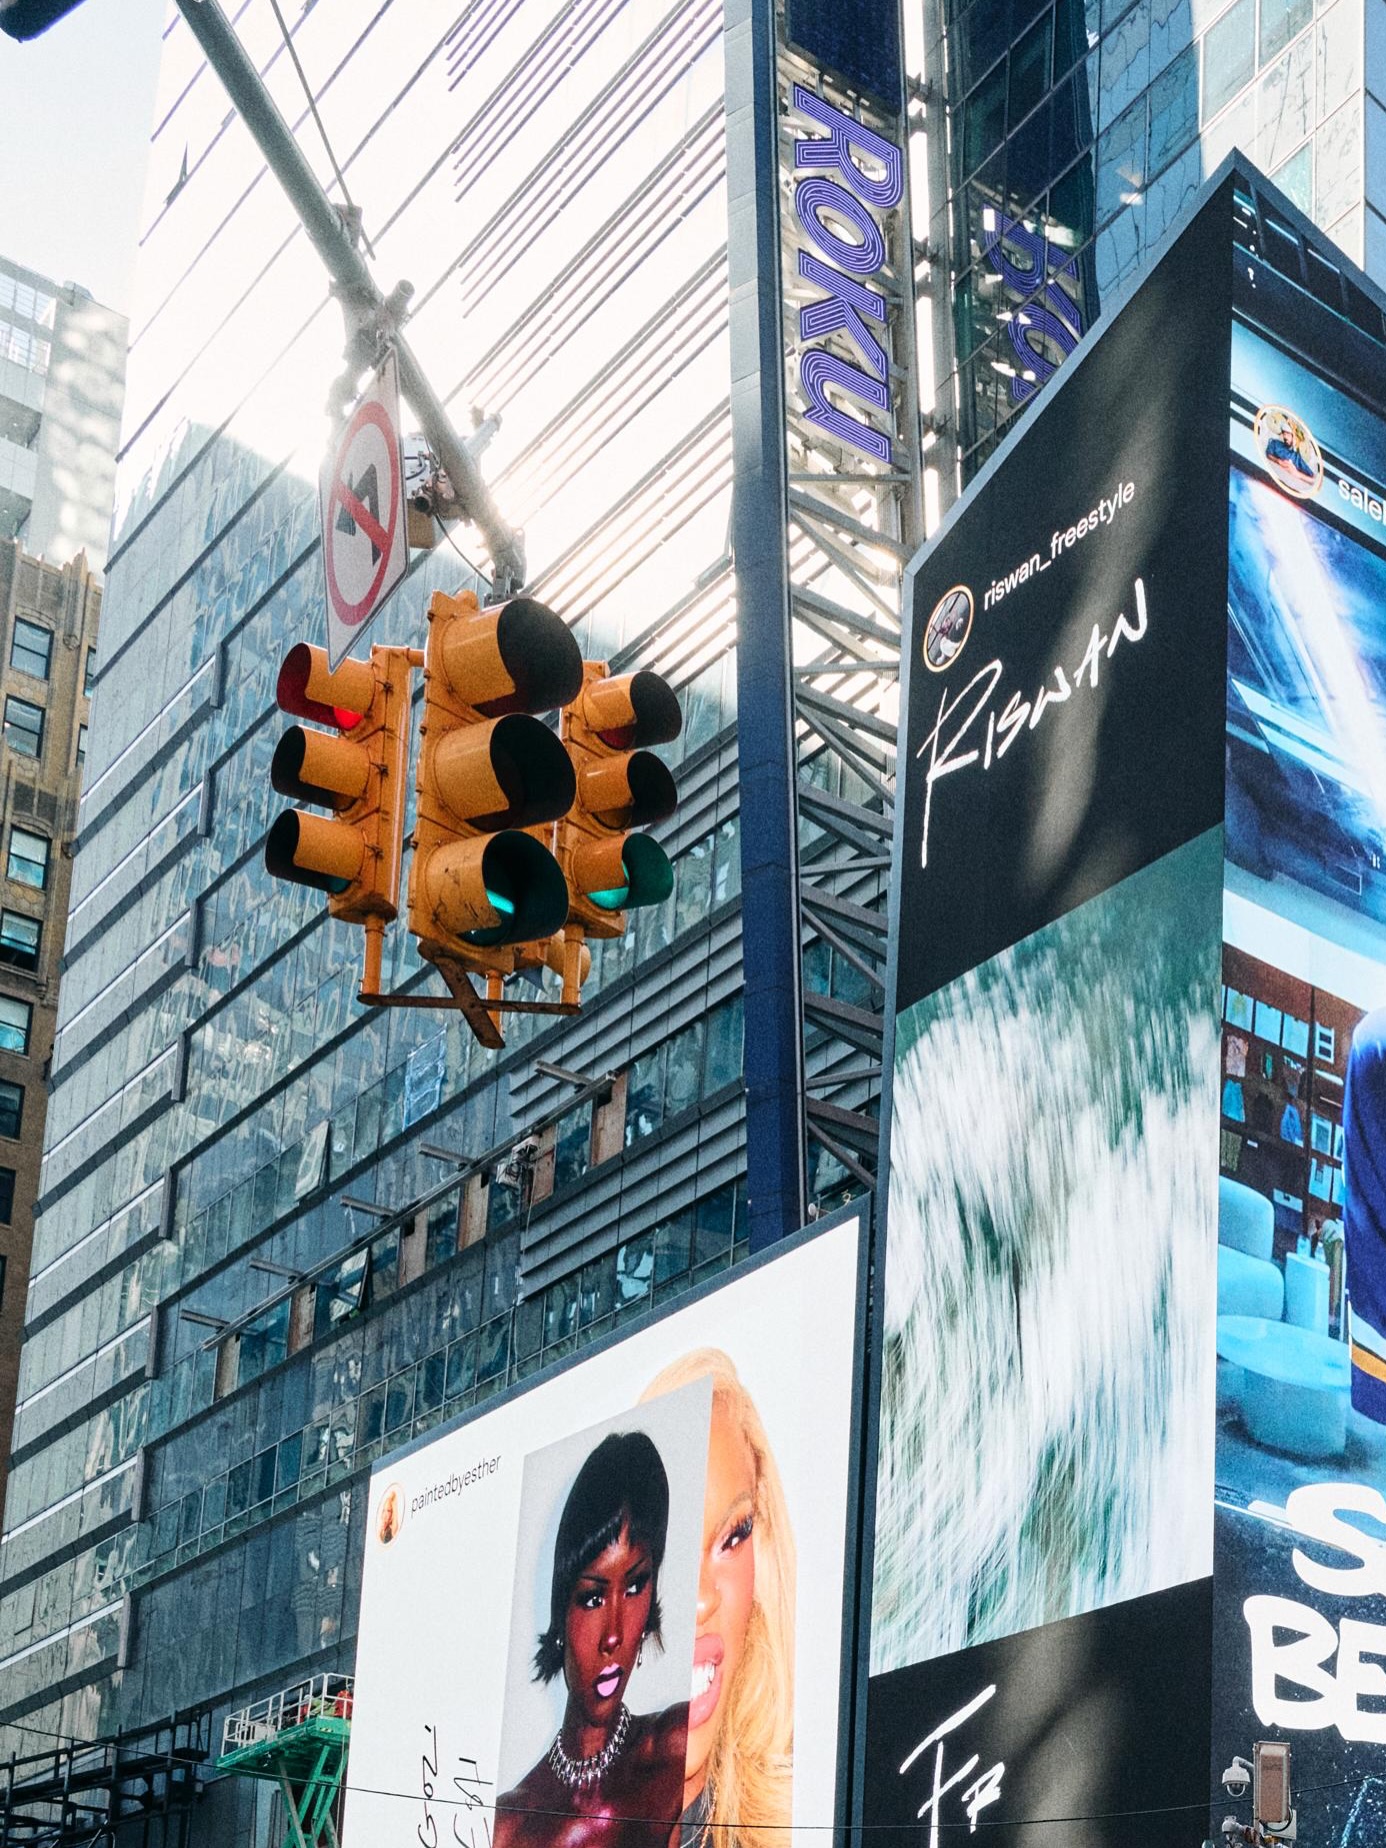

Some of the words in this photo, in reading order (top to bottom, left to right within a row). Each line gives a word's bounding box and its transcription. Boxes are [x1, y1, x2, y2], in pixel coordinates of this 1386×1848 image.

[794, 83, 903, 463] ROKU
[983, 480, 1135, 611] riswan_freestyle
[410, 1455, 502, 1519] paintedbyesther
